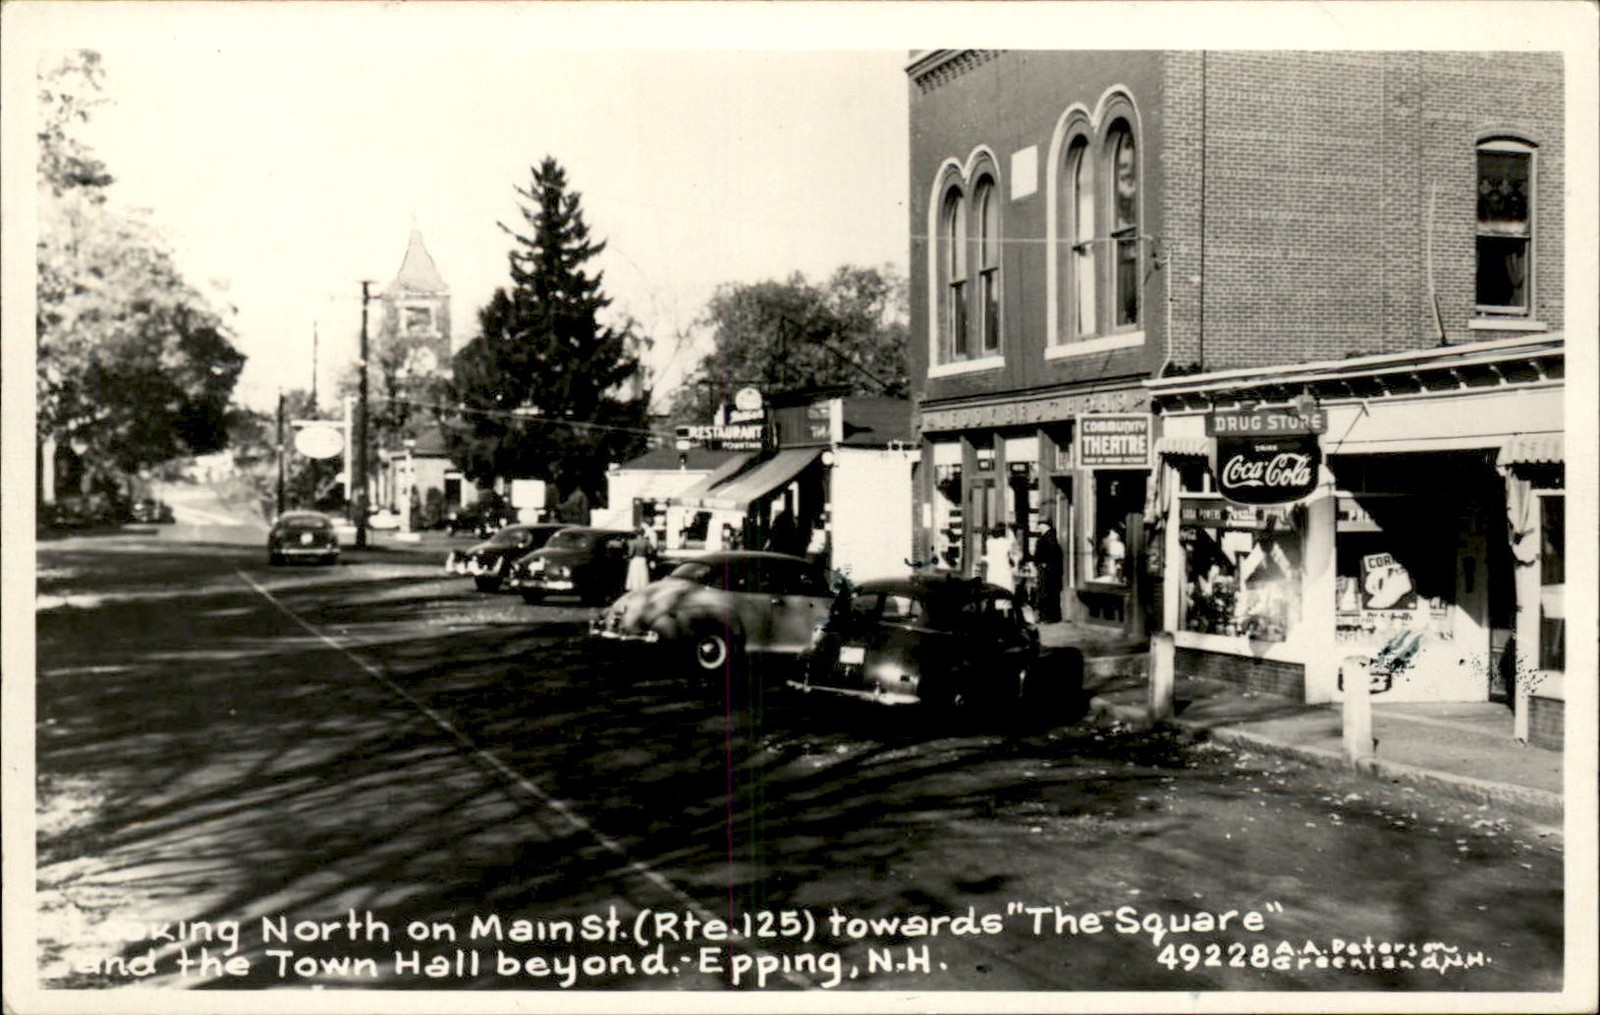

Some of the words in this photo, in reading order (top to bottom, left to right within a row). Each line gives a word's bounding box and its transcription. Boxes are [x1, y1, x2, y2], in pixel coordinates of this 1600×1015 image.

[1083, 420, 1146, 433] COMMUNITY
[1214, 416, 1261, 432] DRUG
[1267, 414, 1322, 431] STORE
[689, 425, 763, 440] RESTAURANT
[1082, 434, 1146, 455] THEATRE
